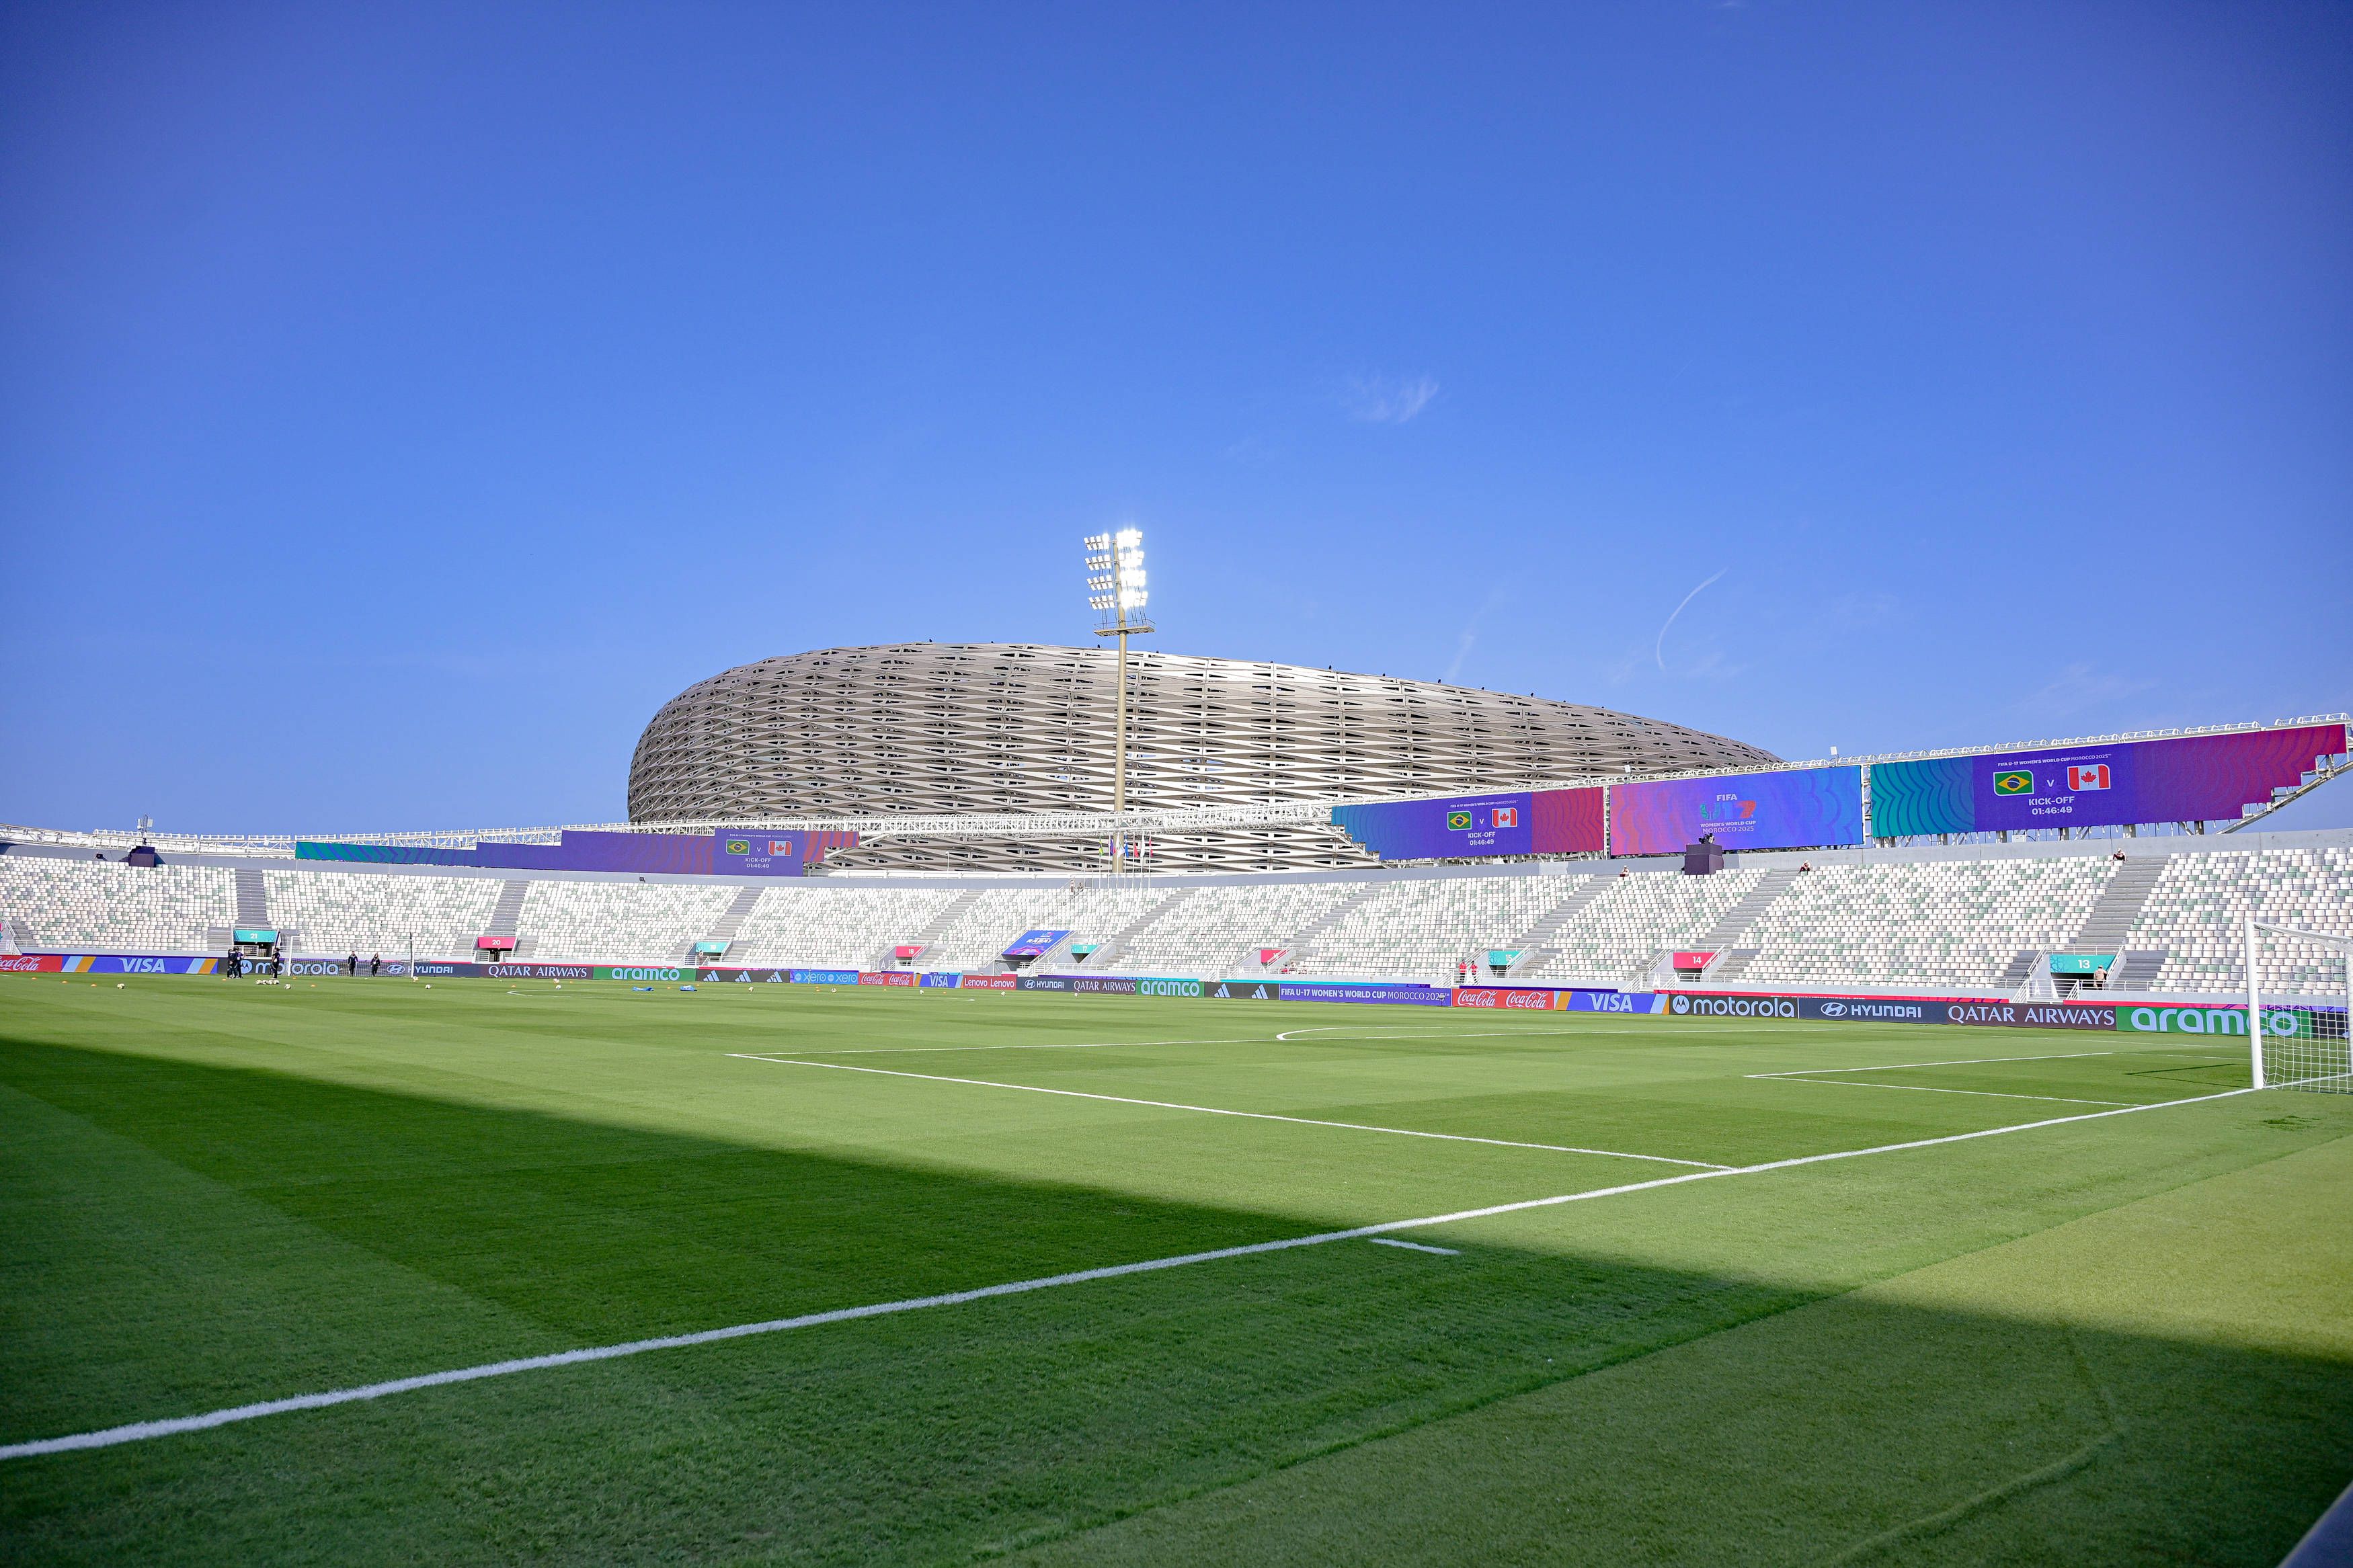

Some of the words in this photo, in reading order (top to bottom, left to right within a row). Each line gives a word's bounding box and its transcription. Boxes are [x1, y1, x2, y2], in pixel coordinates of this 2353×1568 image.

[1716, 794, 1738, 802] FIFA
[2028, 796, 2075, 806] KICK-OFF
[2032, 806, 2073, 815] 01:46:49
[118, 958, 165, 973] VISA
[1692, 956, 1702, 964] 14
[2077, 959, 2091, 969] 13
[488, 965, 530, 978] QATAR
[536, 966, 587, 977] AIRWAYS
[612, 967, 680, 981] aramco
[803, 973, 826, 982] xero
[836, 974, 858, 983] xero
[861, 973, 885, 985] Coca-Cola
[889, 974, 911, 985] Coca-Cola
[929, 975, 949, 987] VISA
[964, 977, 988, 987] Lenovo
[990, 978, 1015, 988] Lenovo
[1036, 981, 1064, 989] HYUNDAI
[1074, 981, 1099, 992] QATAR
[1103, 981, 1135, 992] AIRWAYS
[1141, 981, 1200, 997] aramco
[1312, 989, 1344, 997] WOMEN'S
[1345, 990, 1371, 998] WORLD
[1372, 991, 1386, 999] CUP
[1388, 991, 1425, 1000] MOROCCO
[1458, 989, 1497, 1007] Coca-Cola
[1506, 991, 1548, 1008] Coca-Cola
[1587, 993, 1633, 1011] VISA
[1693, 997, 1794, 1018] motorola
[1851, 1004, 1921, 1018] HYUNDAI
[1948, 1005, 2016, 1024] QATAR
[2024, 1007, 2116, 1026] AIRWAYS
